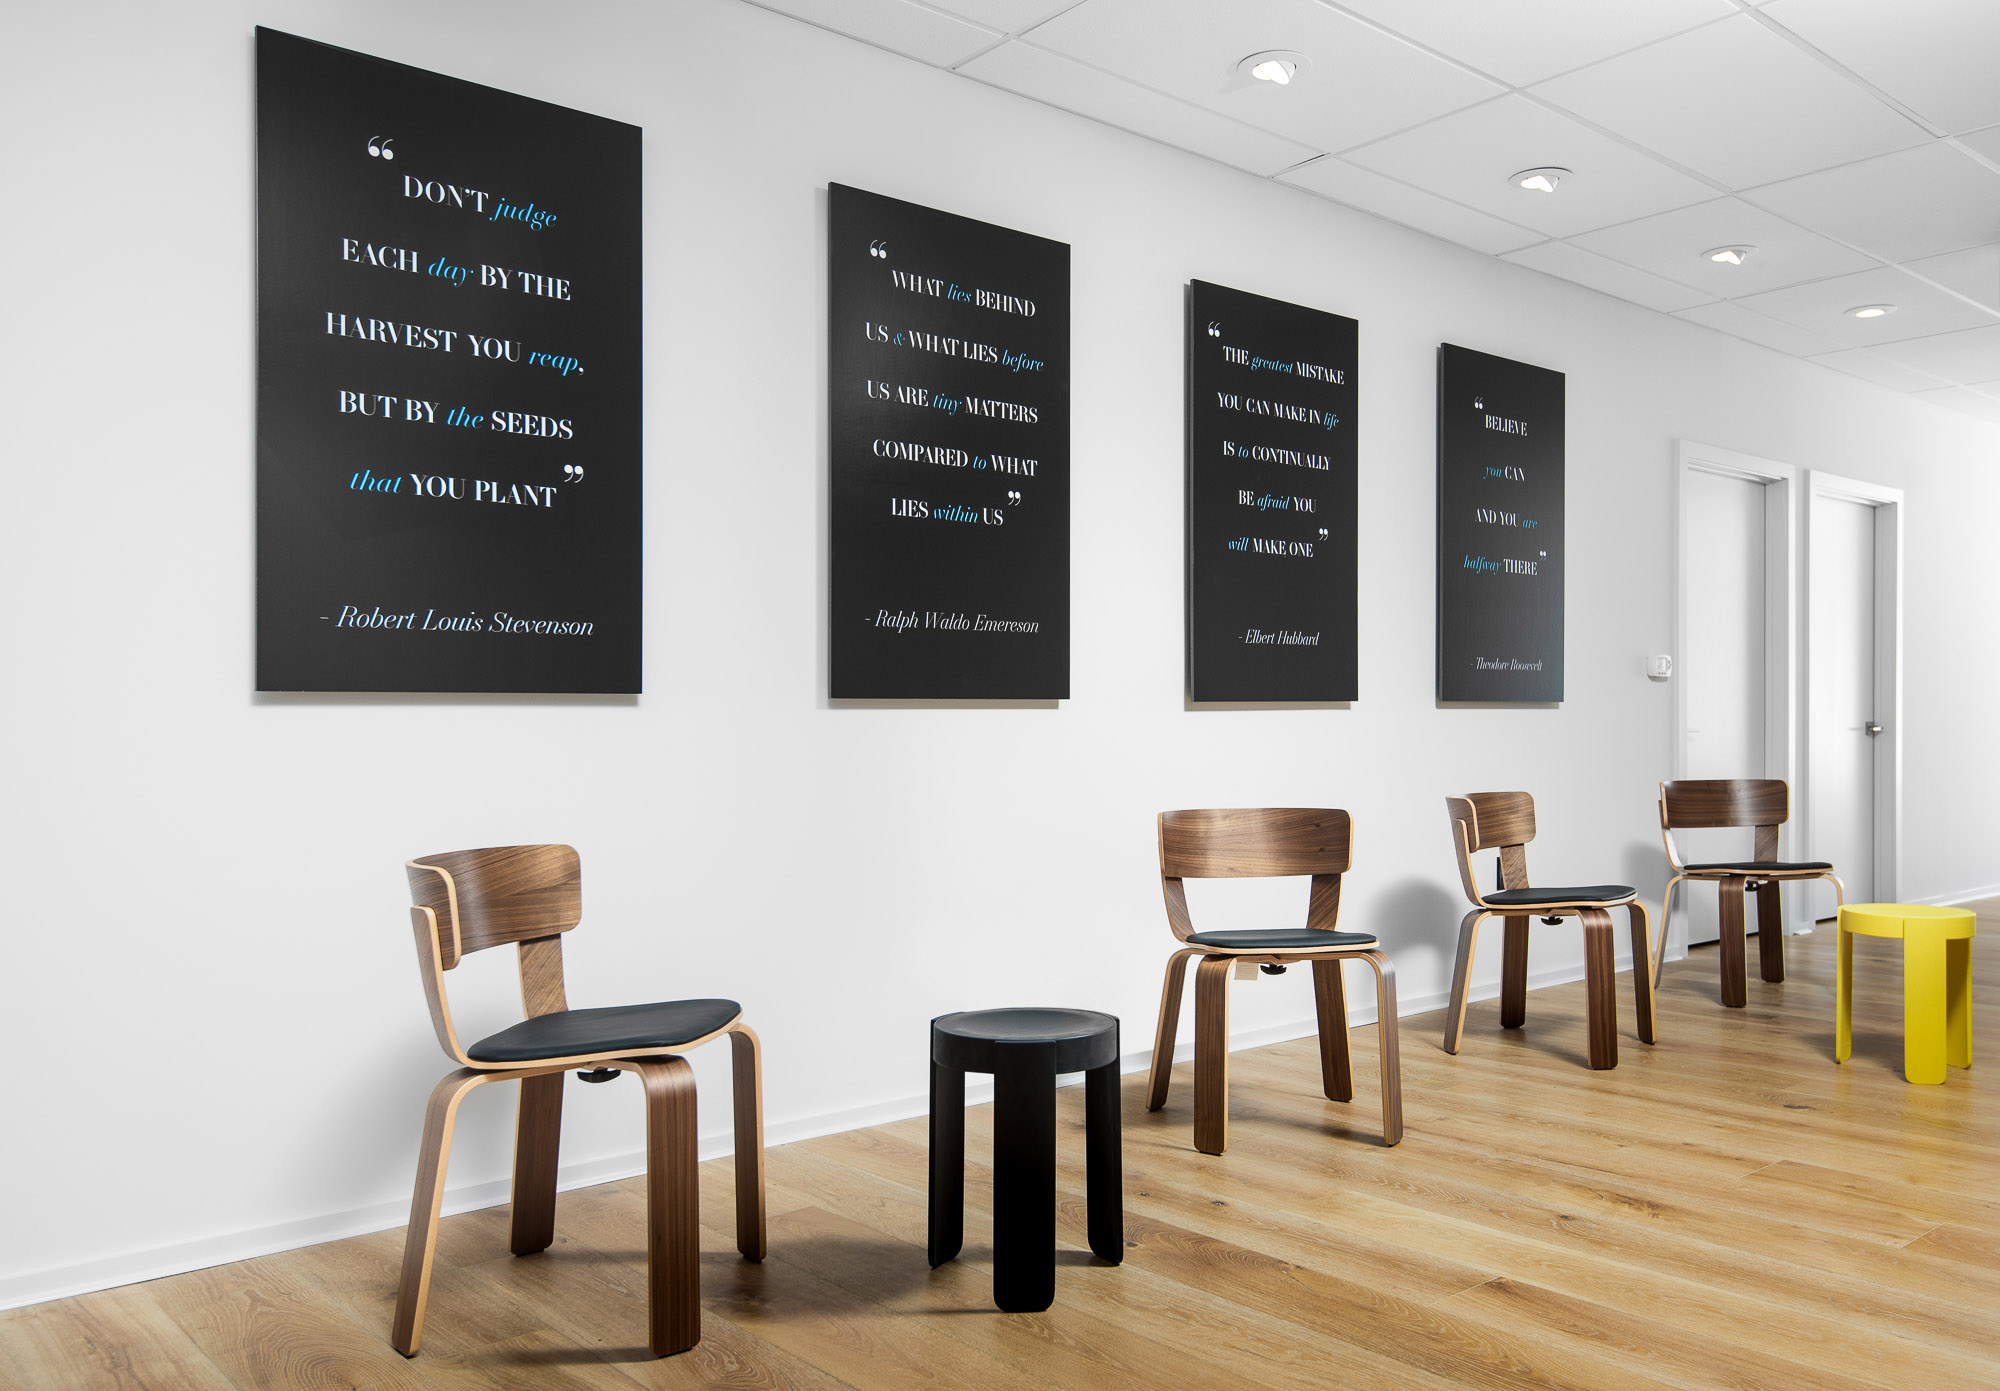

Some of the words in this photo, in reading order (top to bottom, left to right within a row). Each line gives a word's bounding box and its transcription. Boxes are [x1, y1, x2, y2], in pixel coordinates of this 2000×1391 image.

[403, 174, 489, 213] DON'T
[488, 196, 557, 231] judge
[341, 237, 419, 274] EACH
[427, 256, 475, 287] day
[479, 263, 513, 290] BY
[516, 270, 571, 302] THE
[891, 269, 944, 298] WHAT
[947, 282, 972, 303] lies
[975, 288, 1036, 317] BEHIND
[325, 311, 458, 353] HARVEST
[467, 333, 522, 363] YOU
[865, 321, 889, 343] US
[893, 332, 906, 346] &
[908, 330, 960, 356] WHAT
[963, 340, 998, 364] LIES
[1001, 348, 1044, 373] before
[1222, 345, 1250, 366] THE
[1250, 356, 1294, 374] greatest
[1296, 361, 1345, 385] MISTAKE
[339, 389, 398, 419] BUT
[404, 398, 440, 424] BY
[445, 405, 485, 429] the
[490, 410, 574, 440] SEEDS
[866, 379, 891, 401] US
[893, 384, 929, 407] ARE
[932, 392, 963, 416] tiny
[965, 396, 1039, 424] MATTERS
[1217, 391, 1243, 411] YOU
[1245, 397, 1271, 416] CAN
[1273, 402, 1307, 423] MAKE
[1309, 408, 1321, 425] IN
[1323, 411, 1340, 431] life
[1485, 413, 1528, 437] BELIEVE
[872, 438, 969, 468] COMPARED
[972, 455, 987, 470] to
[990, 454, 1039, 477] WHAT
[1223, 440, 1236, 457] IS
[1237, 445, 1250, 459] to
[1251, 445, 1331, 471] CONTINUALLY
[349, 468, 402, 494] that
[408, 473, 466, 500] YOU
[1482, 466, 1503, 480] you
[1504, 465, 1525, 482] CAN
[891, 497, 929, 519] LIES
[933, 504, 979, 524] within
[1238, 489, 1255, 507] BE
[1256, 493, 1291, 512] afraid
[1293, 496, 1316, 514] YOU
[1475, 507, 1498, 524] AND
[1499, 510, 1520, 528] YOU
[1522, 519, 1538, 529] are
[1228, 536, 1250, 552] will
[1252, 538, 1287, 556] MAKE
[1463, 553, 1502, 576] halfway
[335, 605, 418, 630] Robert
[420, 608, 484, 632] Louis
[487, 611, 594, 636] Stevenson
[874, 609, 919, 634] Ralph
[922, 611, 971, 631] Waldo
[972, 613, 1039, 634] Emereson
[1244, 628, 1275, 645] Elbert
[1276, 630, 1320, 646] Hubbard
[1476, 656, 1510, 671] Theodore
[1509, 658, 1543, 671] Roosevelt
